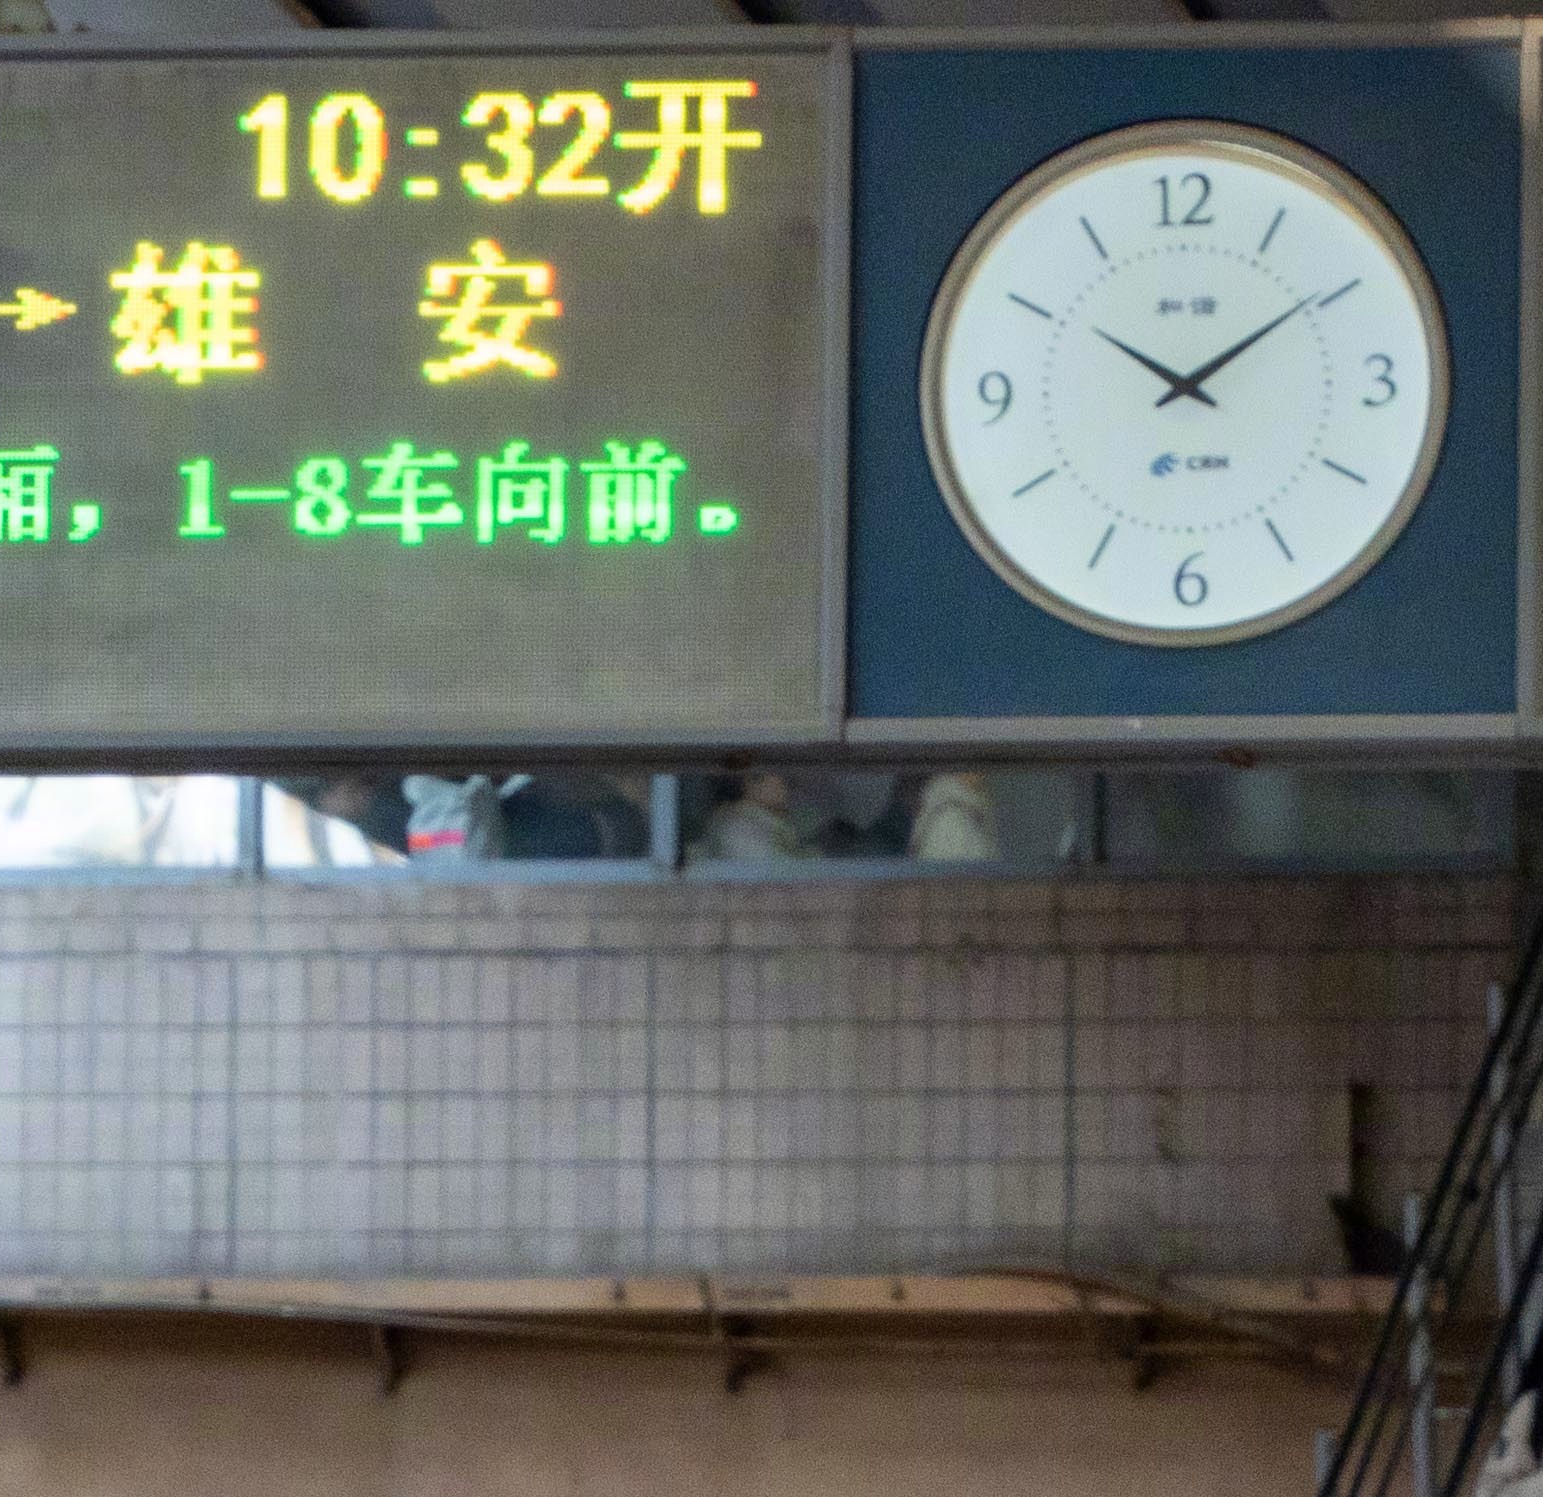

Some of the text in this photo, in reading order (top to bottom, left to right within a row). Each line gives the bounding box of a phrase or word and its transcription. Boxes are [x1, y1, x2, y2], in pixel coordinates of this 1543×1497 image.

[240, 81, 762, 213] 10:32开
[1154, 173, 1213, 227] 12
[979, 371, 1012, 425] 9
[1361, 354, 1398, 408] 3
[1174, 552, 1208, 606] 6
